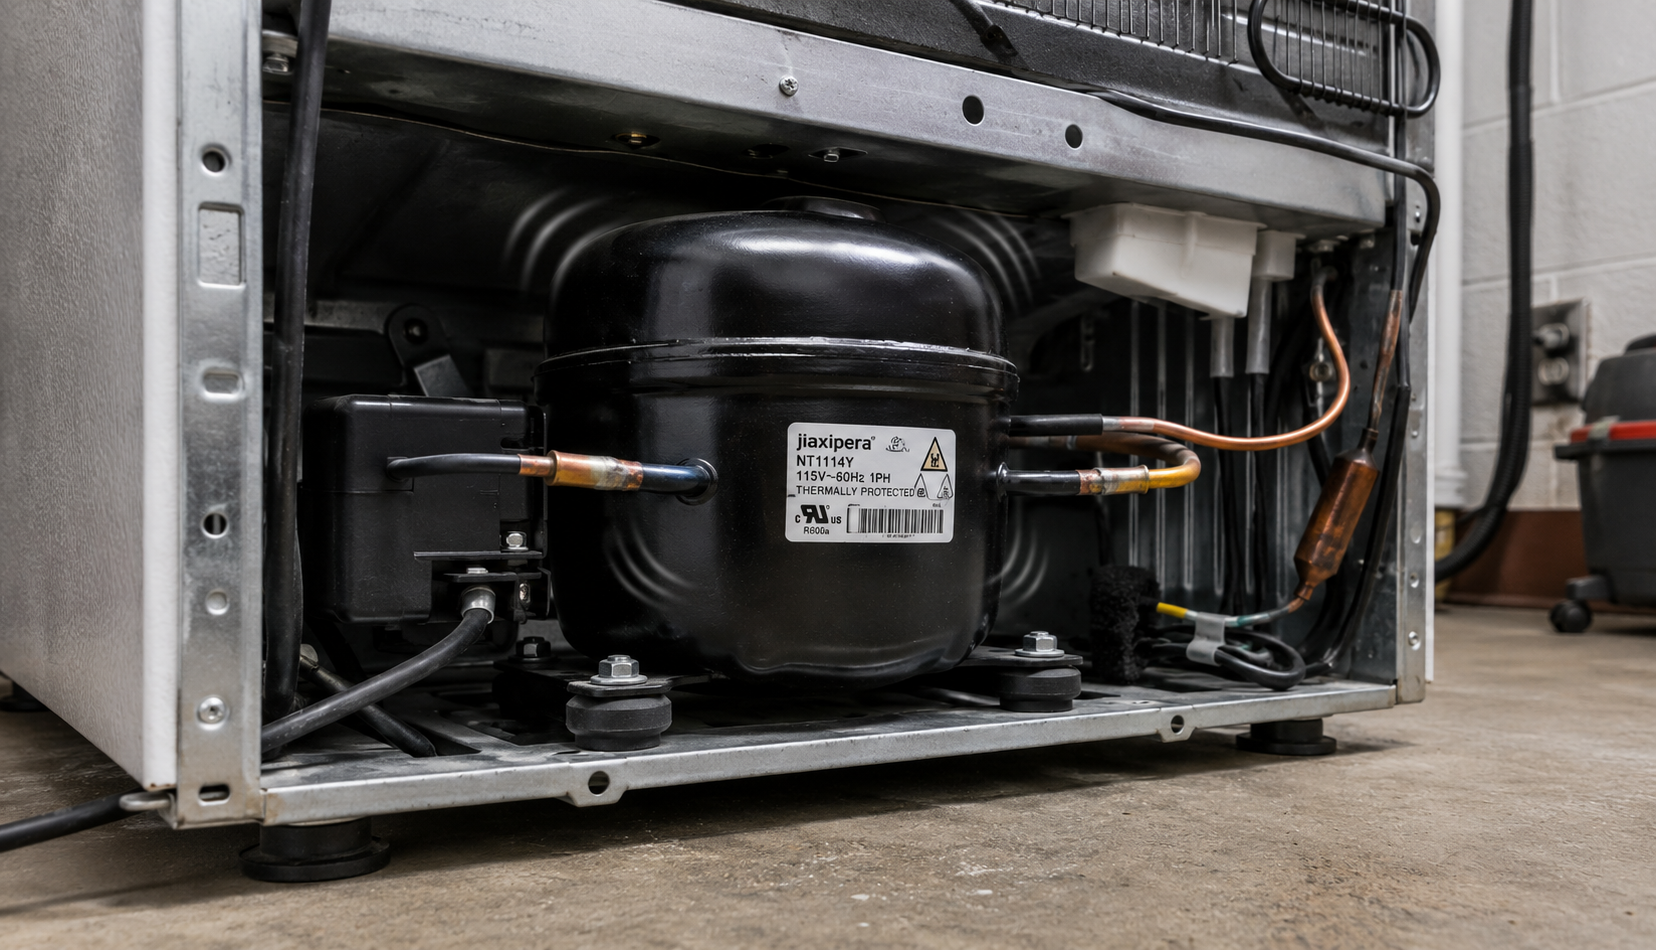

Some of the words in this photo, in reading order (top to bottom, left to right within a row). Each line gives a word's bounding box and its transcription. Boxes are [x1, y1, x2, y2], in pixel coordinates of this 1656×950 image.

[796, 454, 854, 468] NT1114Y
[870, 472, 891, 484] 1PH
[796, 485, 858, 497] THERMALLY
[860, 487, 915, 497] PROTECTED
